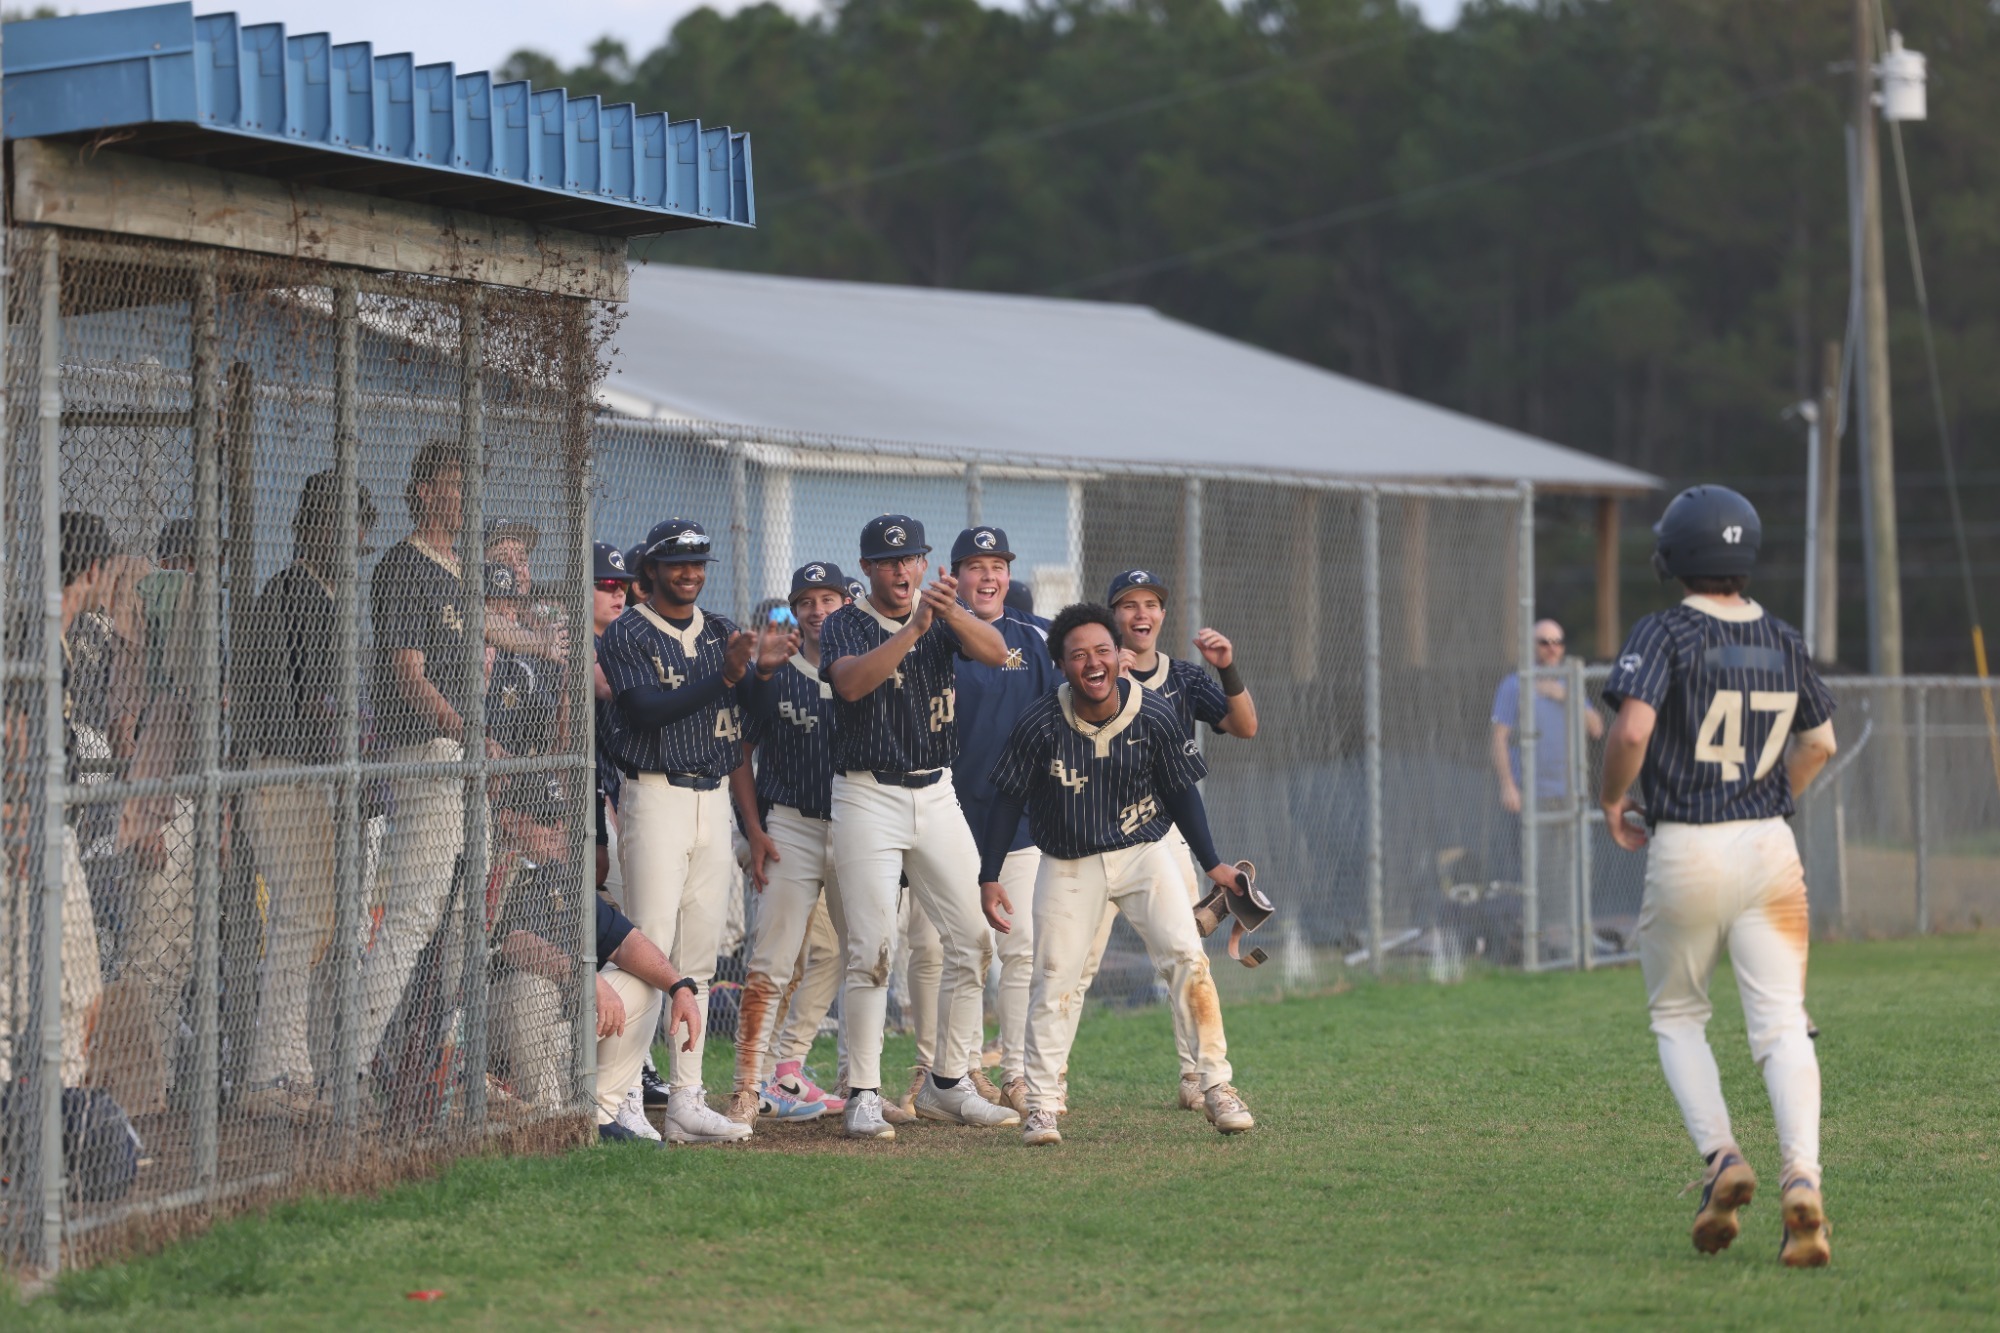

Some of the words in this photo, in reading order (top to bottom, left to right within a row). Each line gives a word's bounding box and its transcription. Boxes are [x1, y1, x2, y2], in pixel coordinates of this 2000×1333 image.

[1722, 526, 1744, 544] 47
[778, 701, 818, 734] BUF
[1694, 689, 1799, 782] 47
[1050, 758, 1088, 794] BUF
